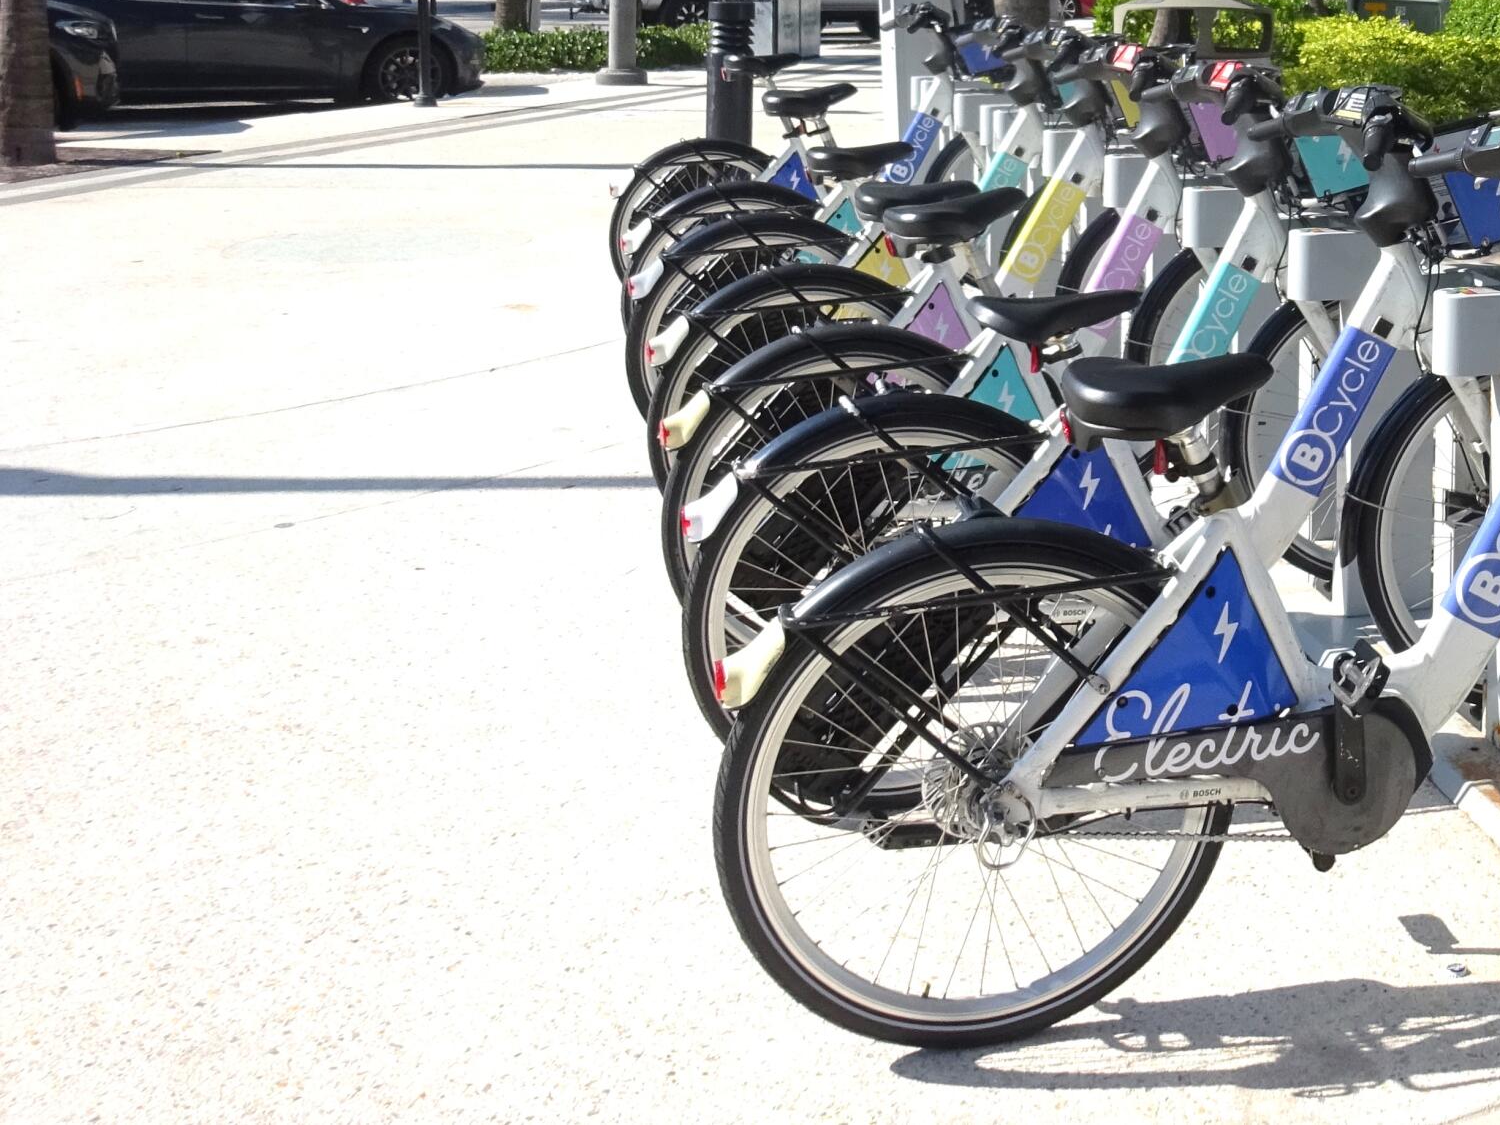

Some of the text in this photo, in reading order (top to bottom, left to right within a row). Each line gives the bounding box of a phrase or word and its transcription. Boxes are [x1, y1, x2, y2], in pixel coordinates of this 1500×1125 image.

[1012, 186, 1076, 278] BCycle
[1188, 274, 1247, 359] Cycle
[1280, 340, 1380, 486] BCycle
[1094, 680, 1320, 783] Electric
[1193, 788, 1222, 798] BOSCH
